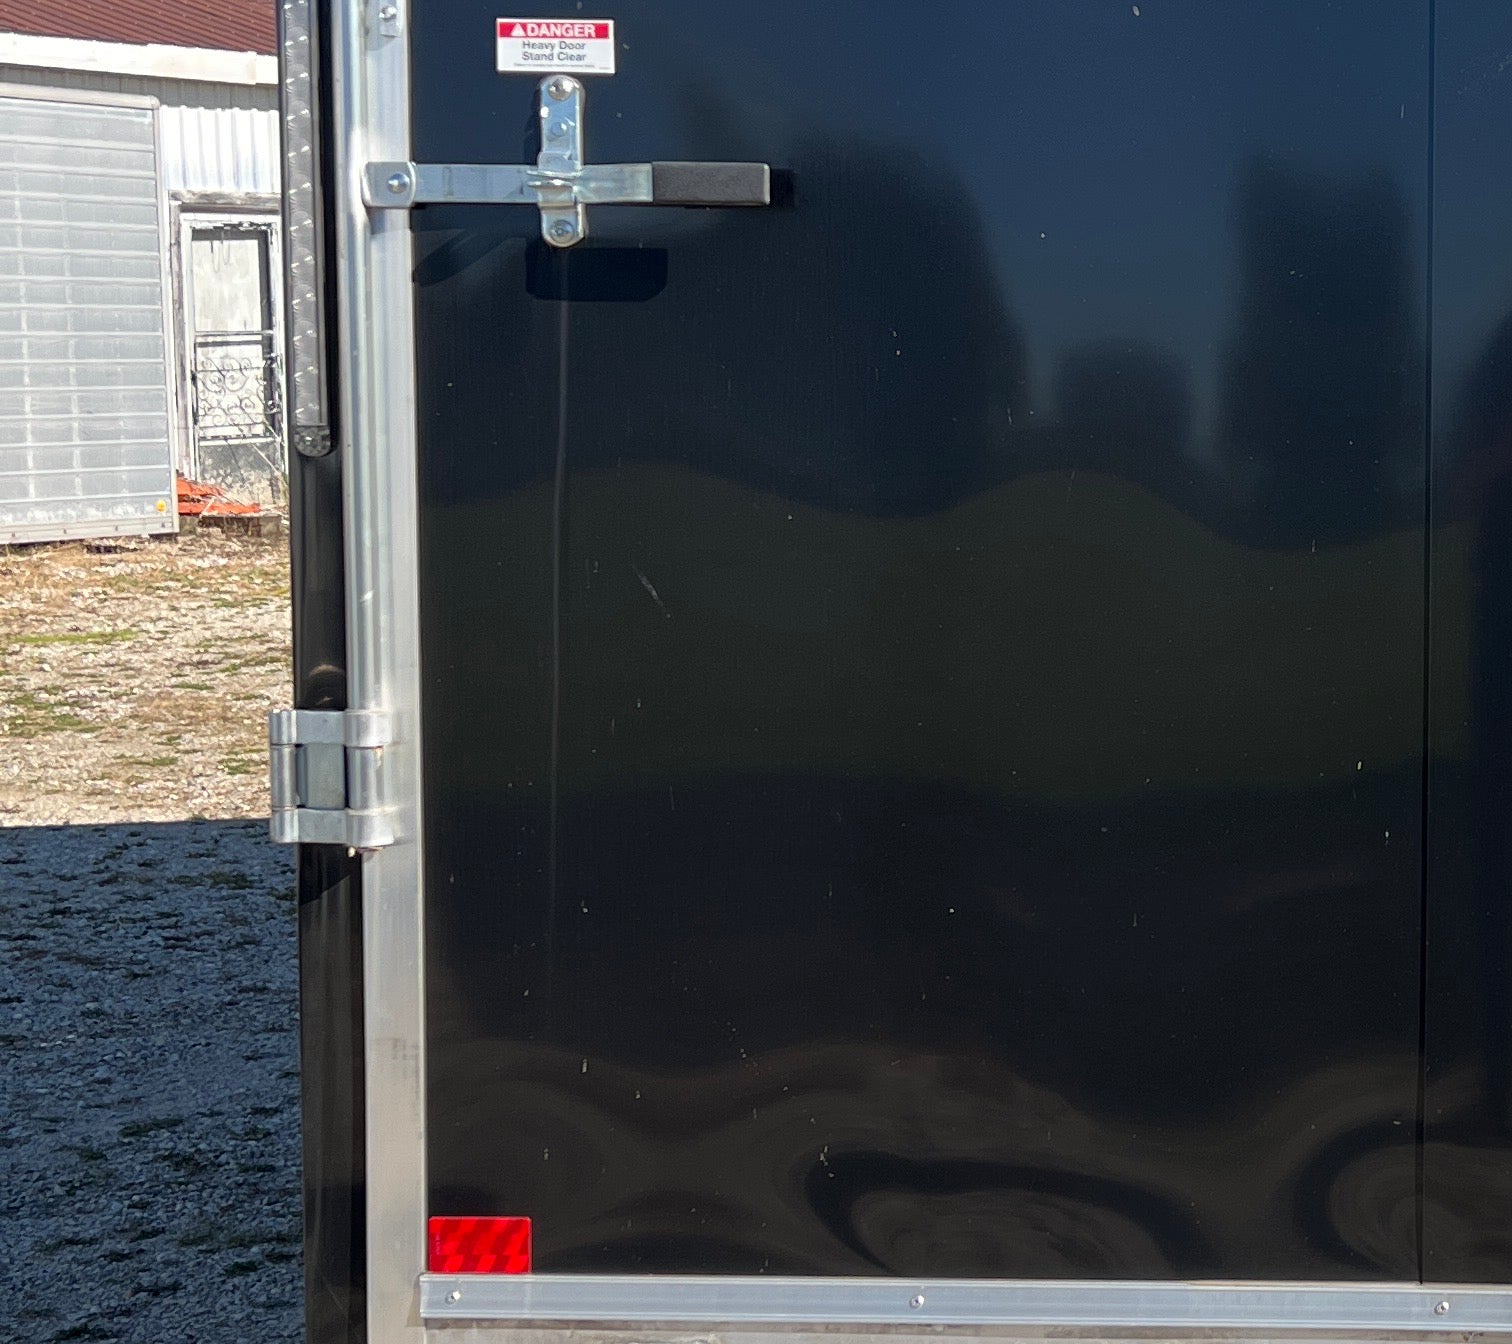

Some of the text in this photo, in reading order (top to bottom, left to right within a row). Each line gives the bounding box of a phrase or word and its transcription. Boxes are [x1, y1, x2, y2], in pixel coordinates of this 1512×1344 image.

[526, 22, 596, 38] DANGER
[522, 40, 586, 51] Heavy Door
[522, 51, 587, 61] Stand Clear
